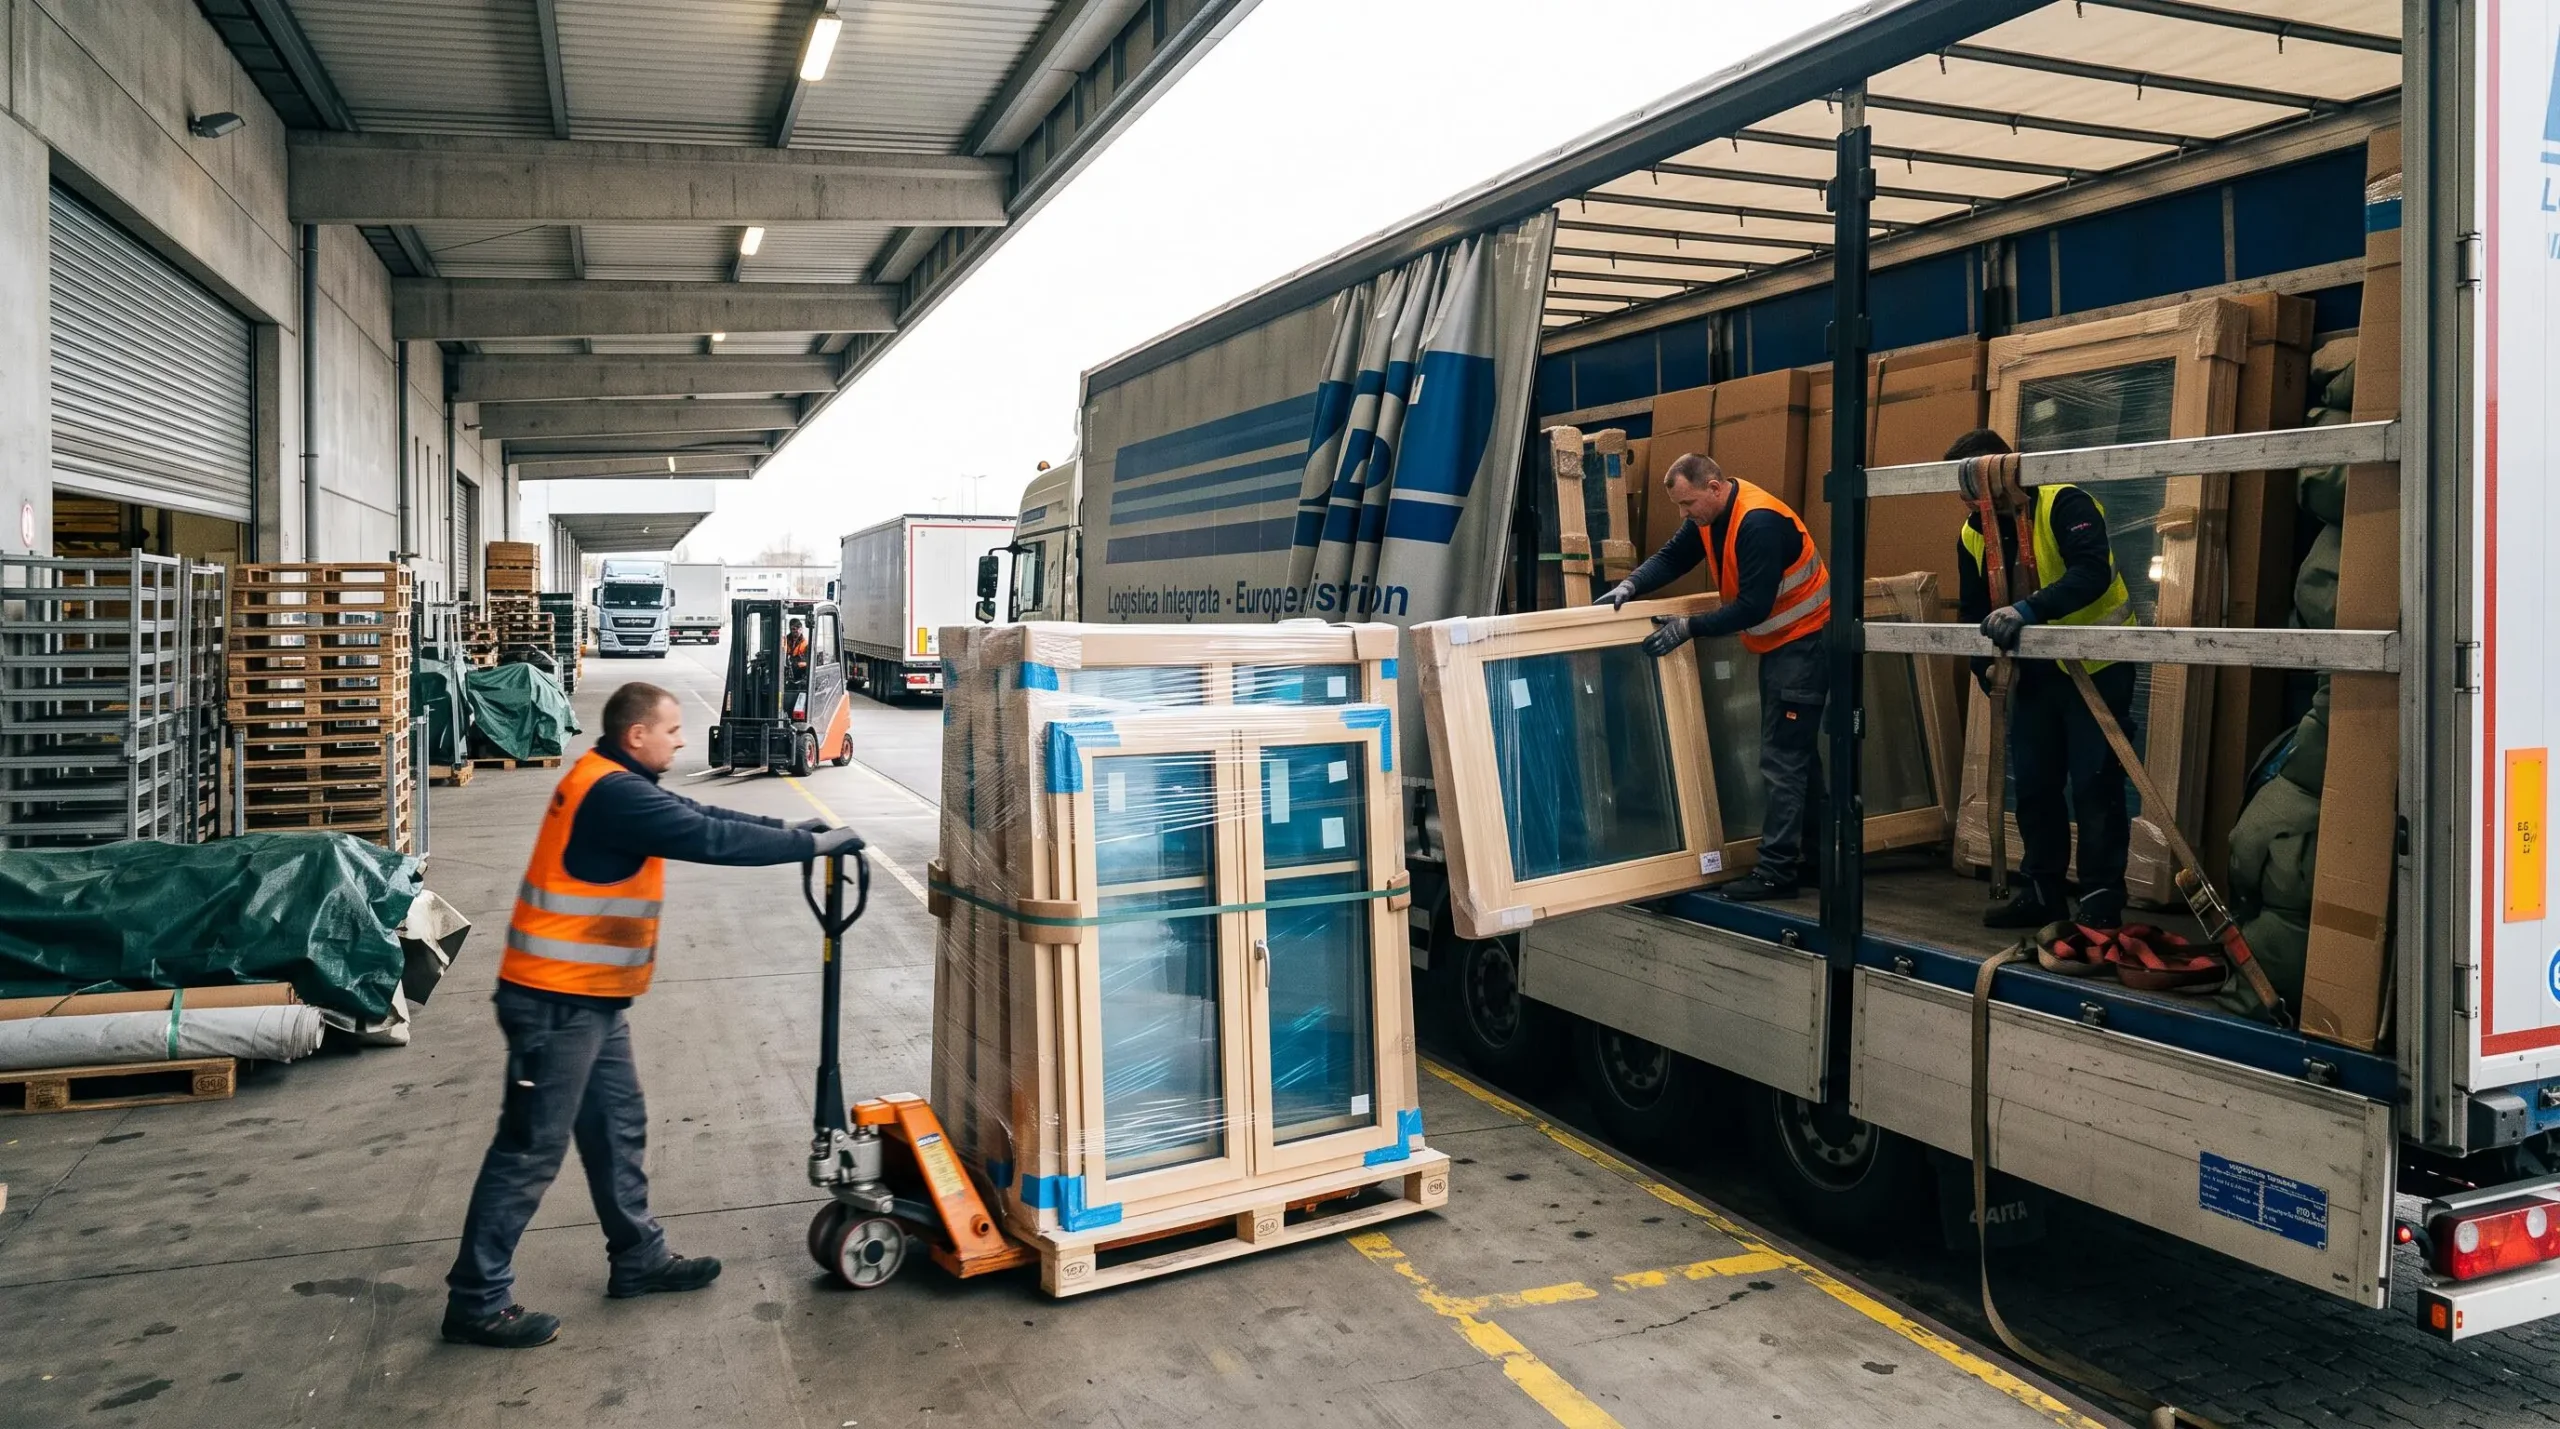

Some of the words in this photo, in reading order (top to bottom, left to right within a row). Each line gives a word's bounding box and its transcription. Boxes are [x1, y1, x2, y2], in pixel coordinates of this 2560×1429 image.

[2541, 177, 2560, 212] L
[1107, 584, 1158, 621] Logistica
[1162, 583, 1220, 622] Integrata
